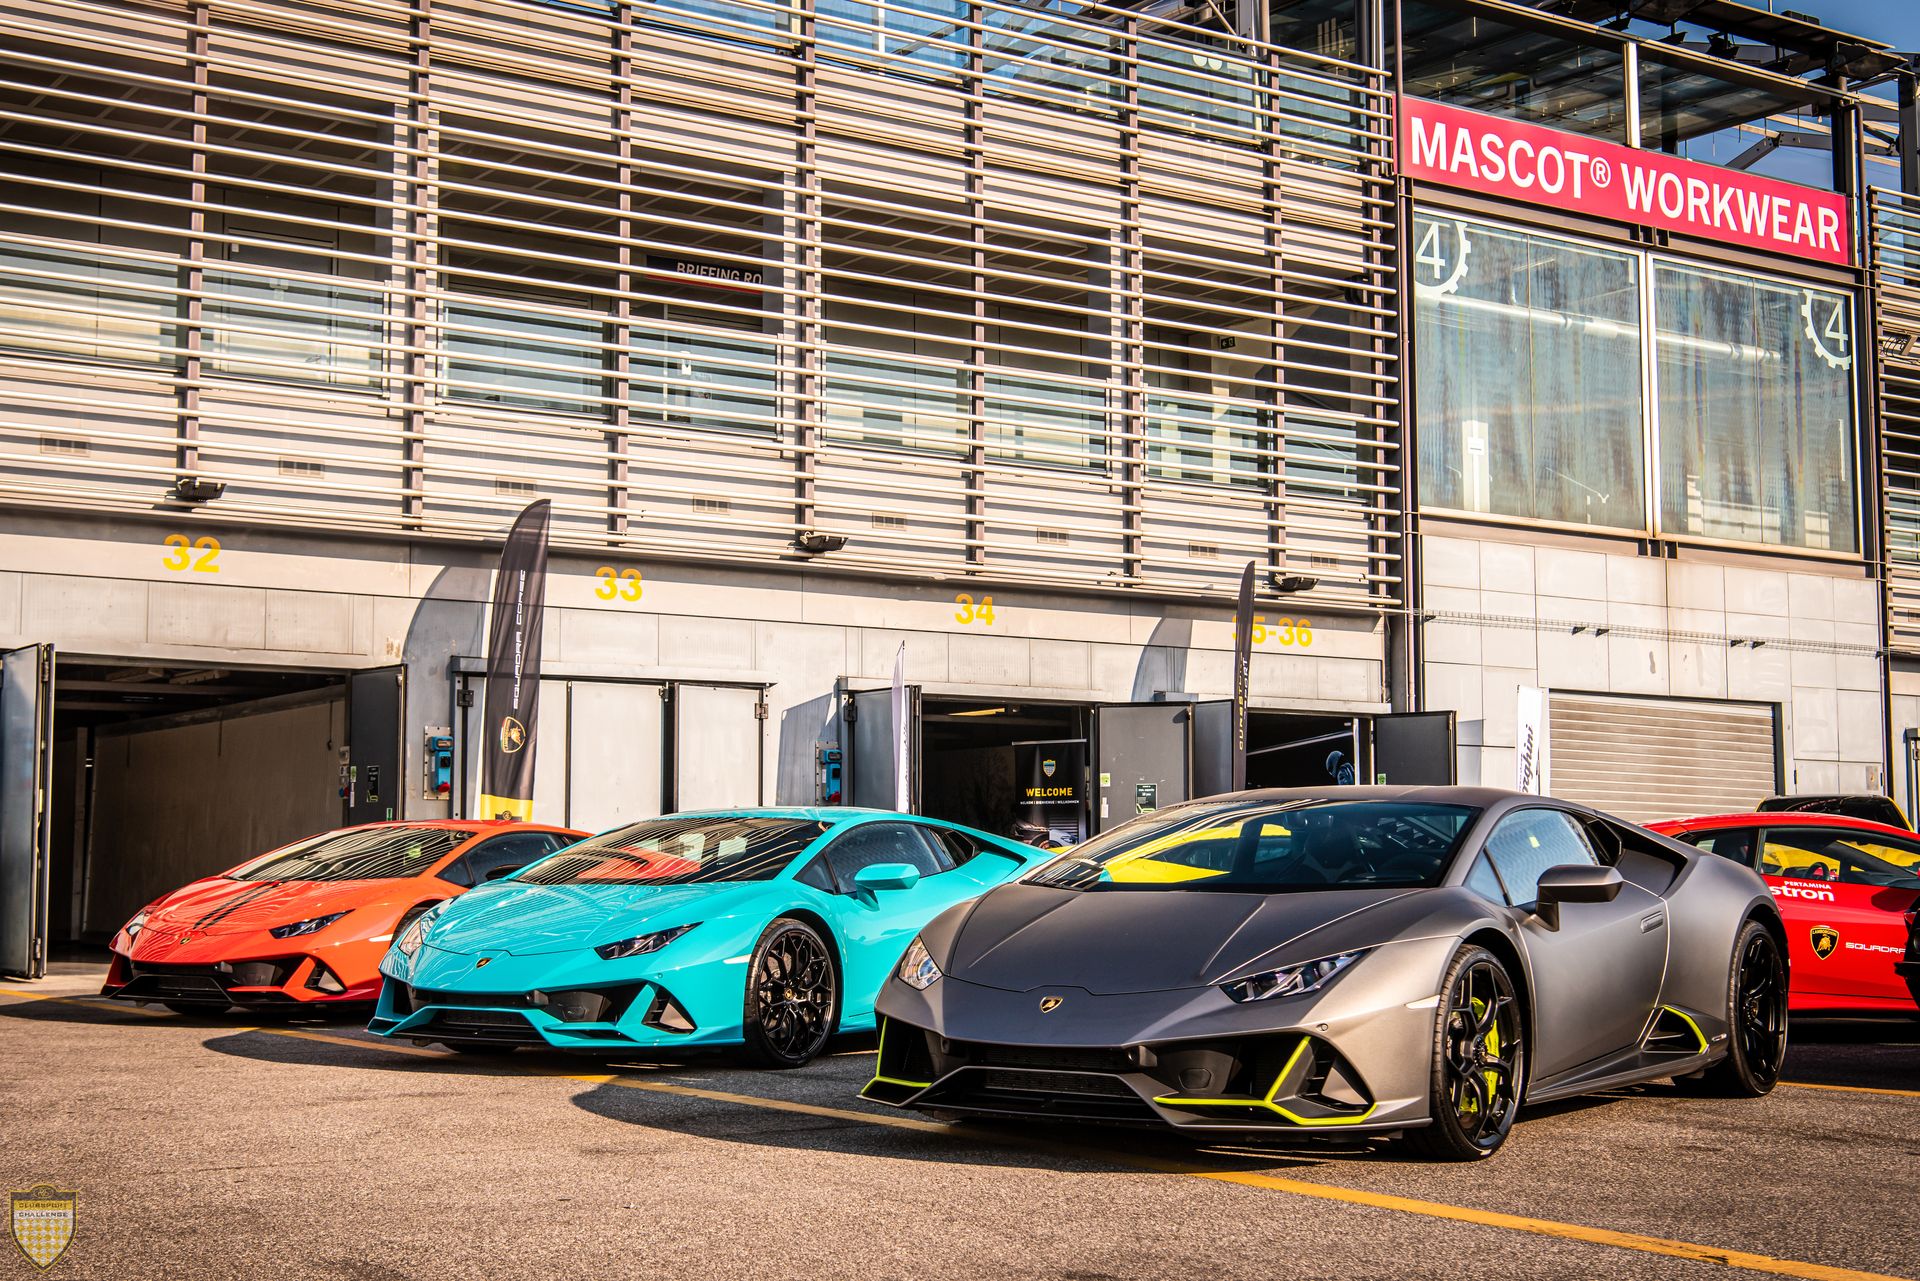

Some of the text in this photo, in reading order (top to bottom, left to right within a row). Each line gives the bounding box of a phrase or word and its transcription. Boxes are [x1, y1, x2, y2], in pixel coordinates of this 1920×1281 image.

[1620, 163, 1841, 252] WORKWEAR
[1416, 222, 1446, 279] 4
[1825, 301, 1848, 352] 4
[163, 533, 222, 573] 32
[595, 566, 642, 602] 33
[955, 593, 996, 626] 34
[1232, 616, 1313, 648] 5-36
[513, 632, 523, 709] SQUADRA
[1025, 787, 1073, 797] WELCOME
[1784, 881, 1832, 890] PERTAMINA
